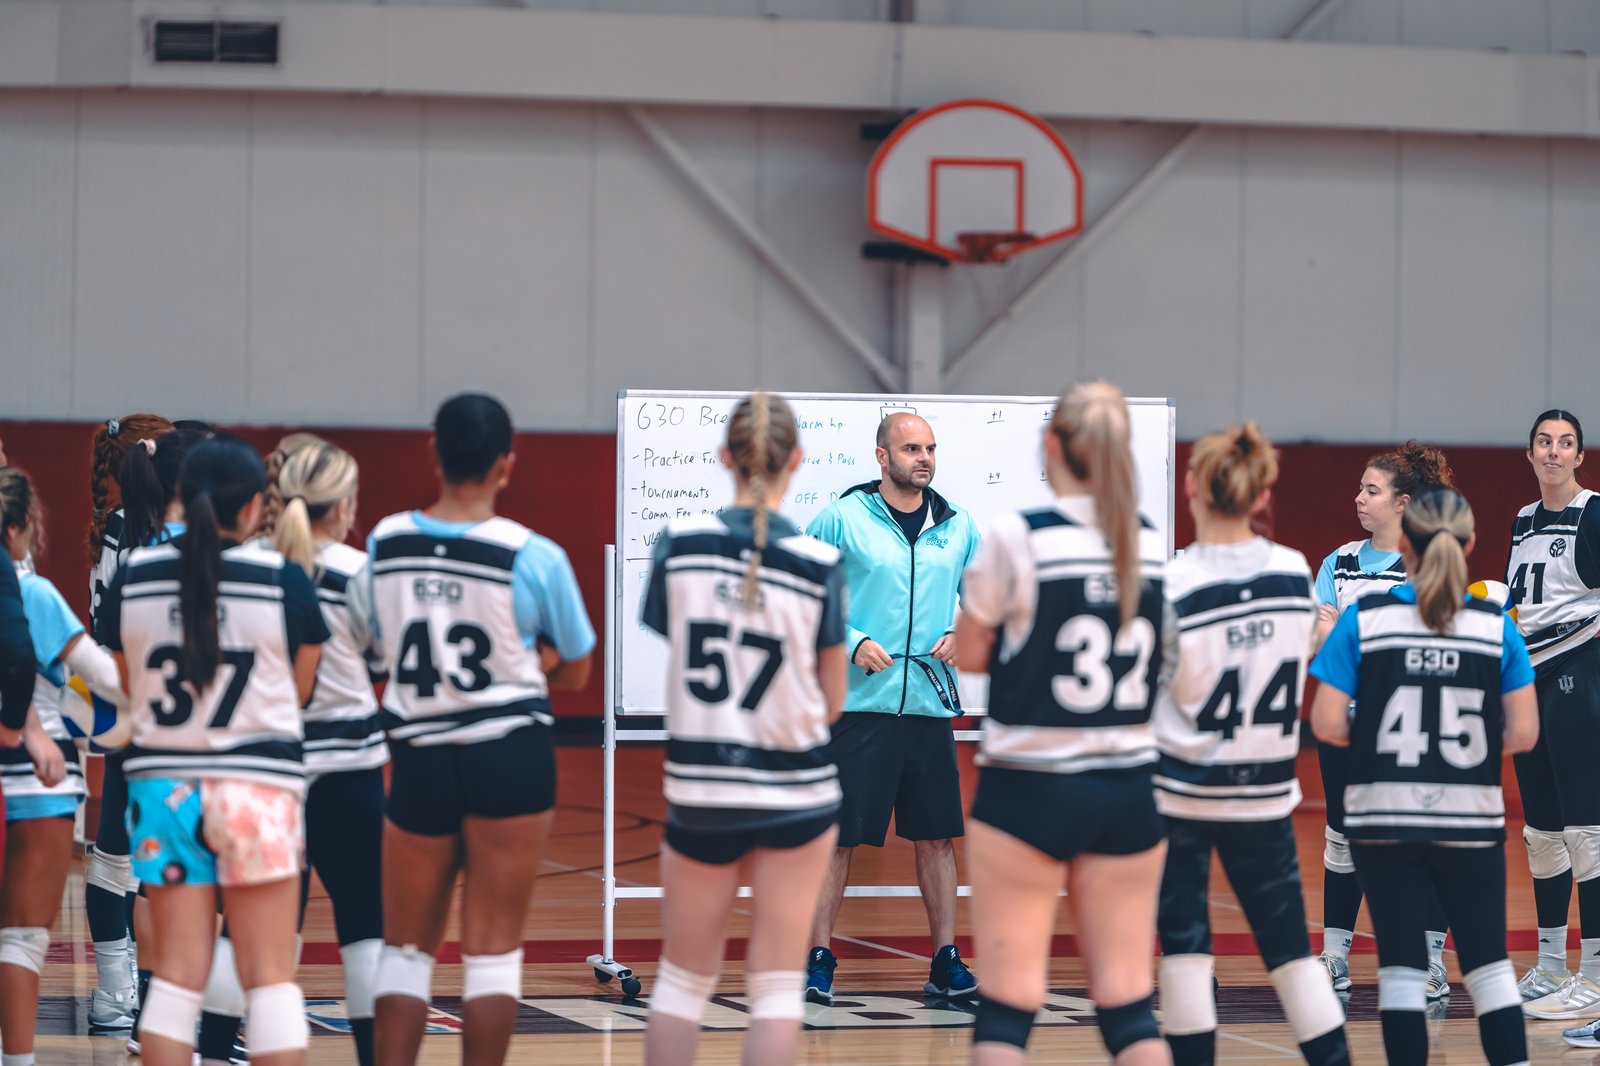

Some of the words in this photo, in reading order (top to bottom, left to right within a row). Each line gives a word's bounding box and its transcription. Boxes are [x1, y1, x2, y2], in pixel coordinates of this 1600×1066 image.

[637, 402, 685, 430] 630
[644, 447, 695, 470] Practice
[413, 578, 463, 606] 630
[1509, 562, 1547, 605] 41
[396, 620, 493, 698] 43
[1225, 619, 1275, 648] 630
[1404, 648, 1460, 671] 630
[146, 643, 255, 729] 37
[685, 619, 784, 712] 57
[1051, 613, 1157, 715] 32
[1196, 658, 1299, 741] 44
[1375, 685, 1489, 770] 45
